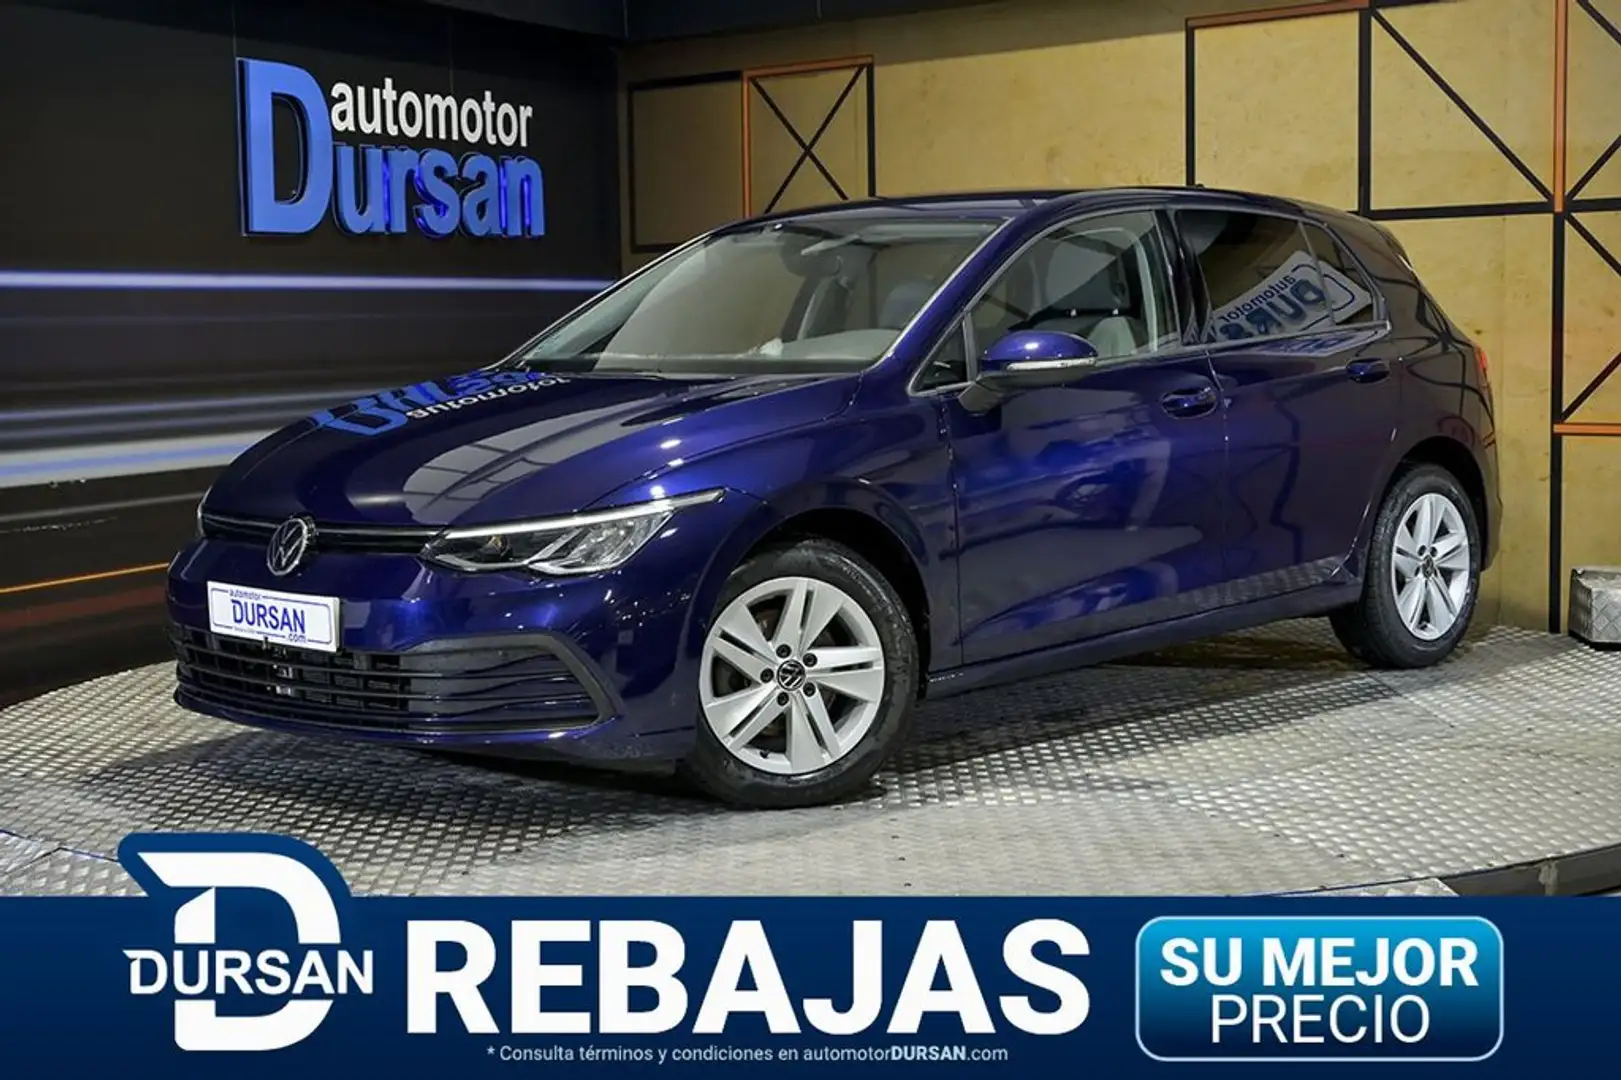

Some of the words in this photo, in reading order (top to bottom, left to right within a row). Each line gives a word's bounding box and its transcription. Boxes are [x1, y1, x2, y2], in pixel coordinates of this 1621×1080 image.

[330, 77, 533, 147] automotor
[236, 57, 546, 238] Dursan
[230, 599, 306, 634] DURSAN
